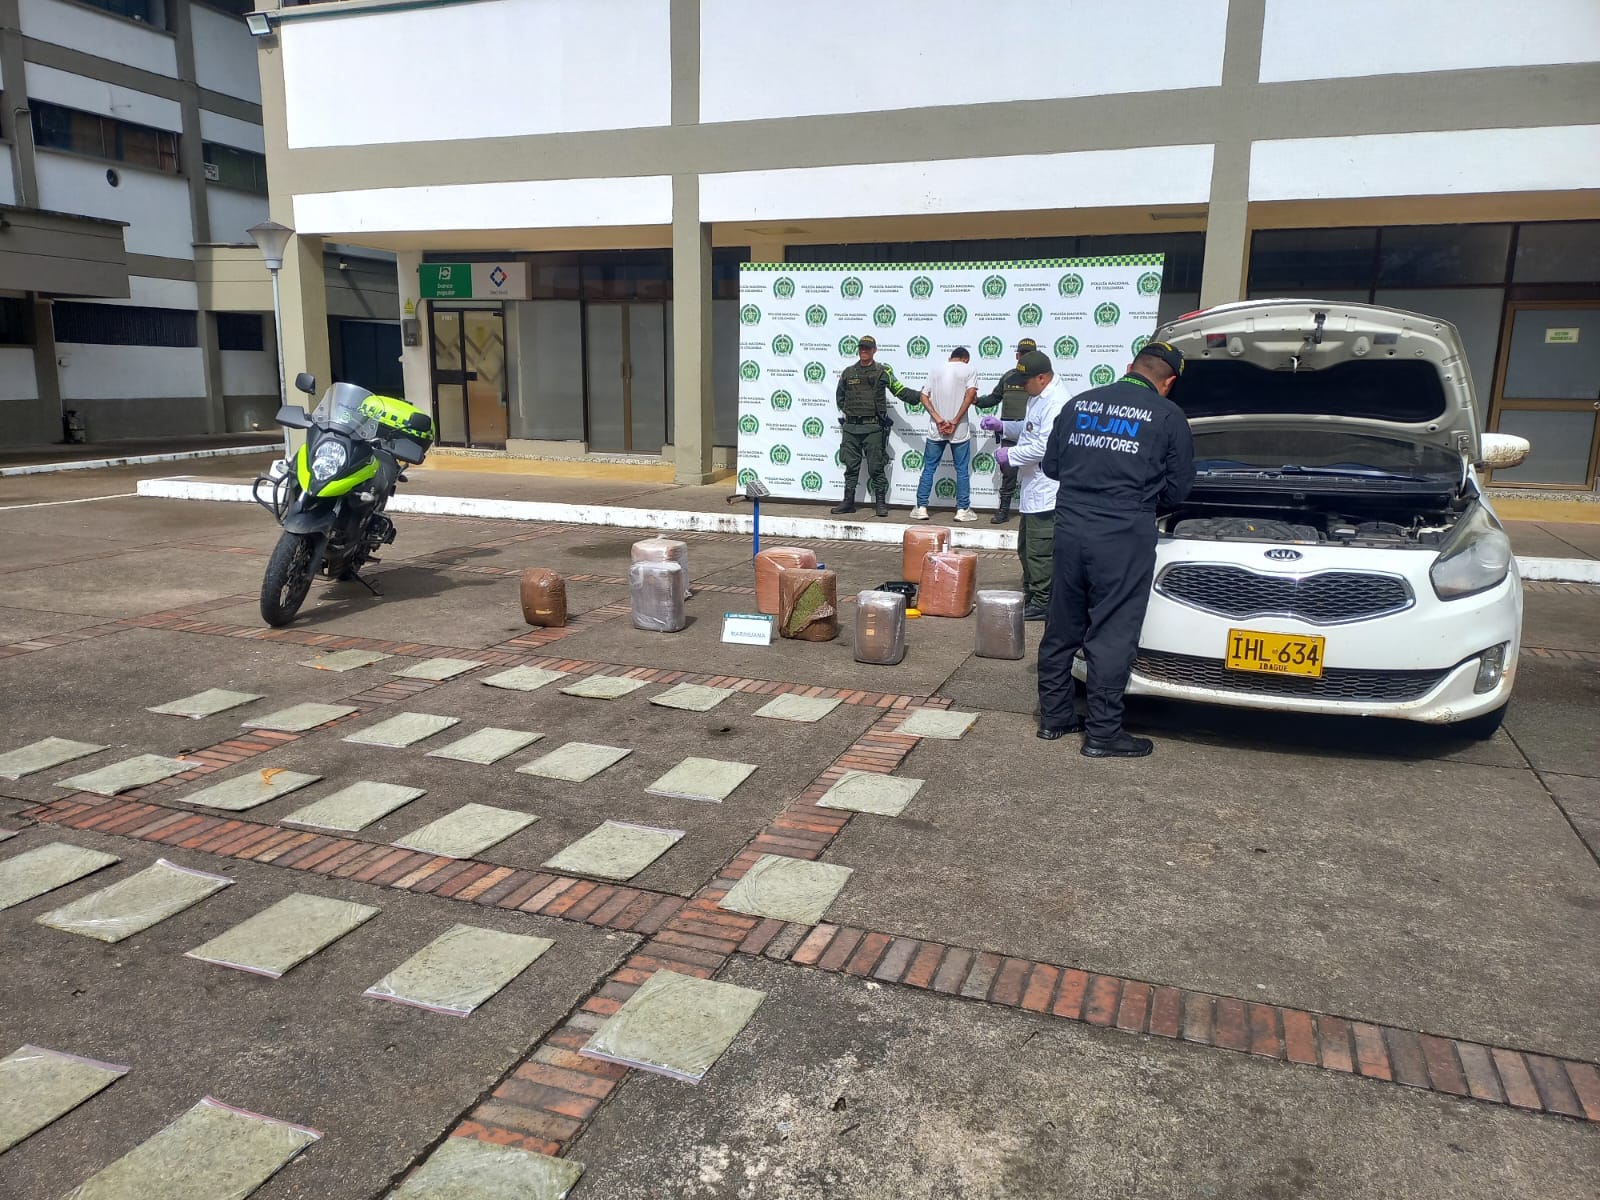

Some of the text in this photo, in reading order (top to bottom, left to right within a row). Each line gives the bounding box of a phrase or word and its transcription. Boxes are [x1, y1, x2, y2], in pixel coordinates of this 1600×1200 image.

[1074, 400, 1152, 421] POLICIA NACIONAL
[1076, 414, 1139, 437] DIJIN
[1068, 433, 1139, 454] AUTOMOTORES
[1232, 637, 1319, 666] IHL 634
[1259, 662, 1288, 672] IBAGUE
